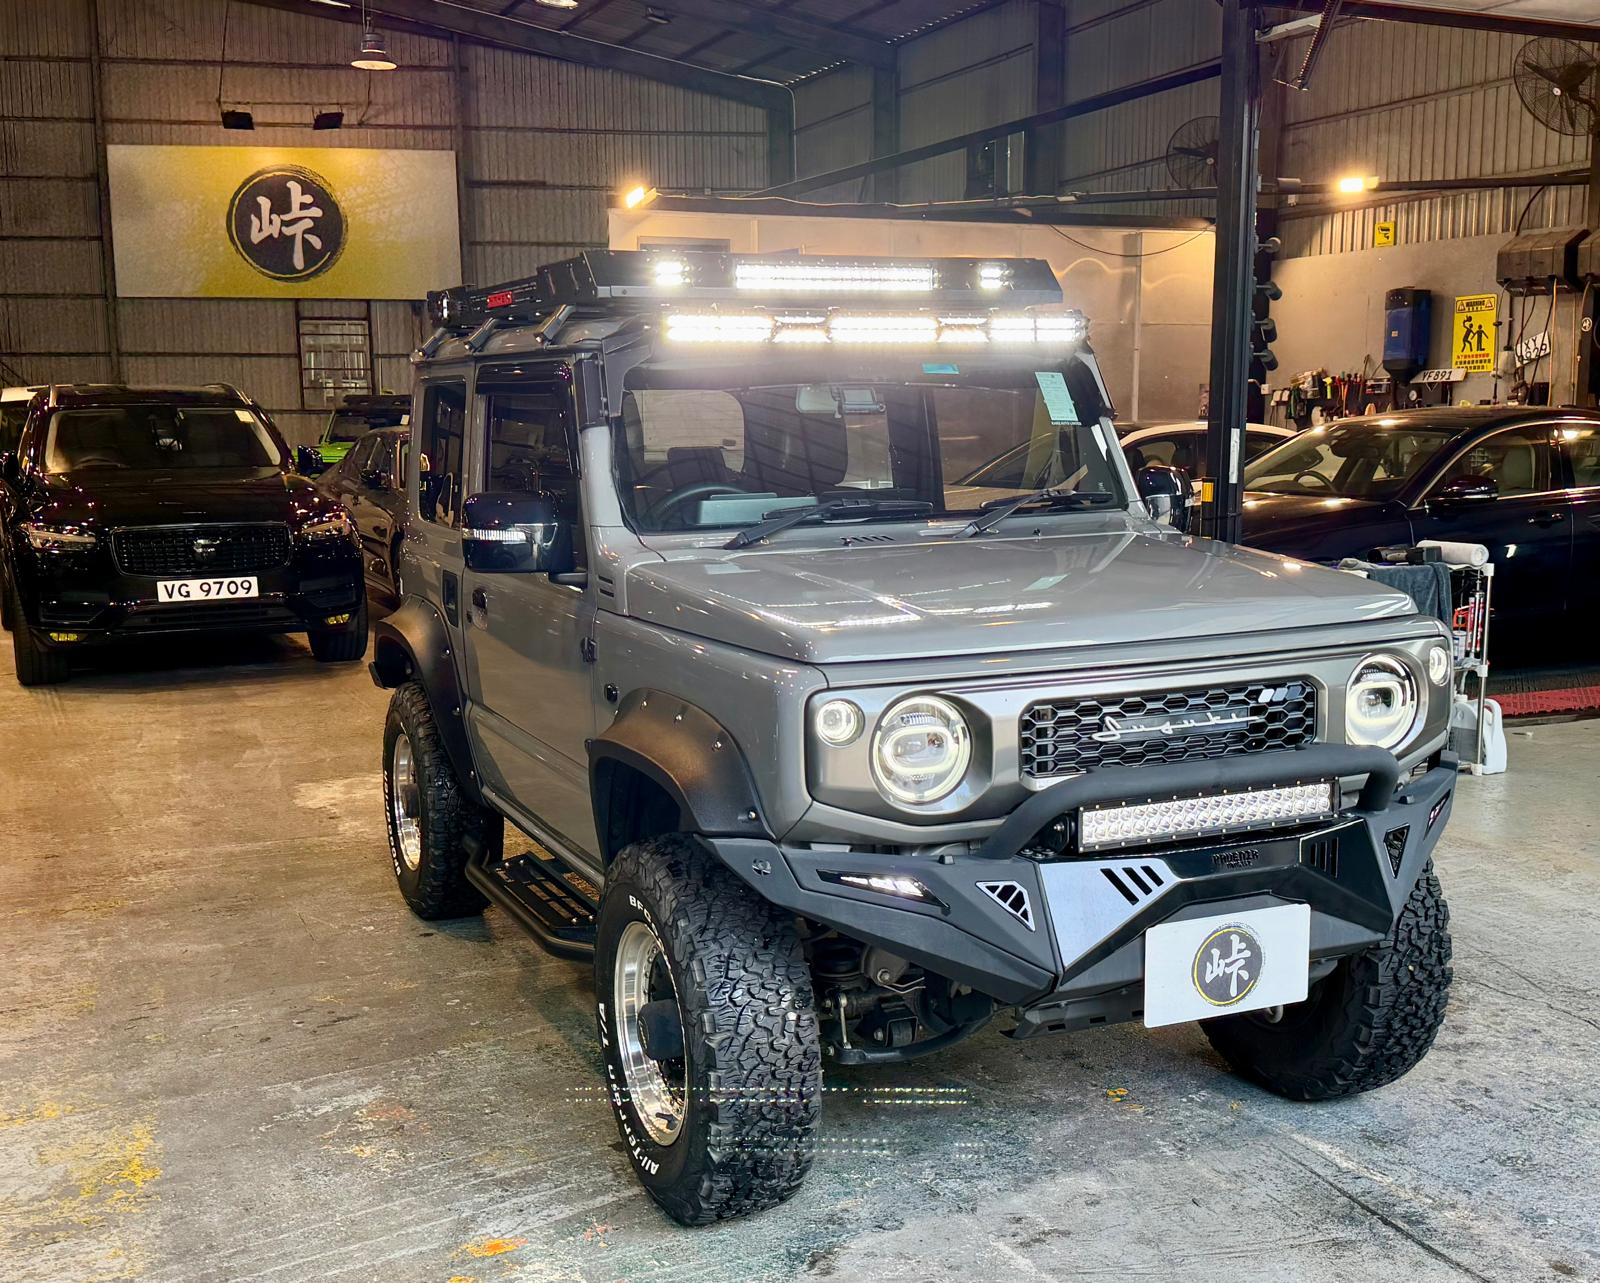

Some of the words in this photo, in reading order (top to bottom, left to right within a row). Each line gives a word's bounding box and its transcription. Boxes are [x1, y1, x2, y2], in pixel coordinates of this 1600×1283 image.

[250, 180, 323, 270] 峠
[1524, 337, 1537, 350] XY
[1422, 371, 1453, 381] YF891
[163, 583, 191, 599] VG
[199, 579, 252, 597] 9709
[1205, 933, 1251, 997] 峠
